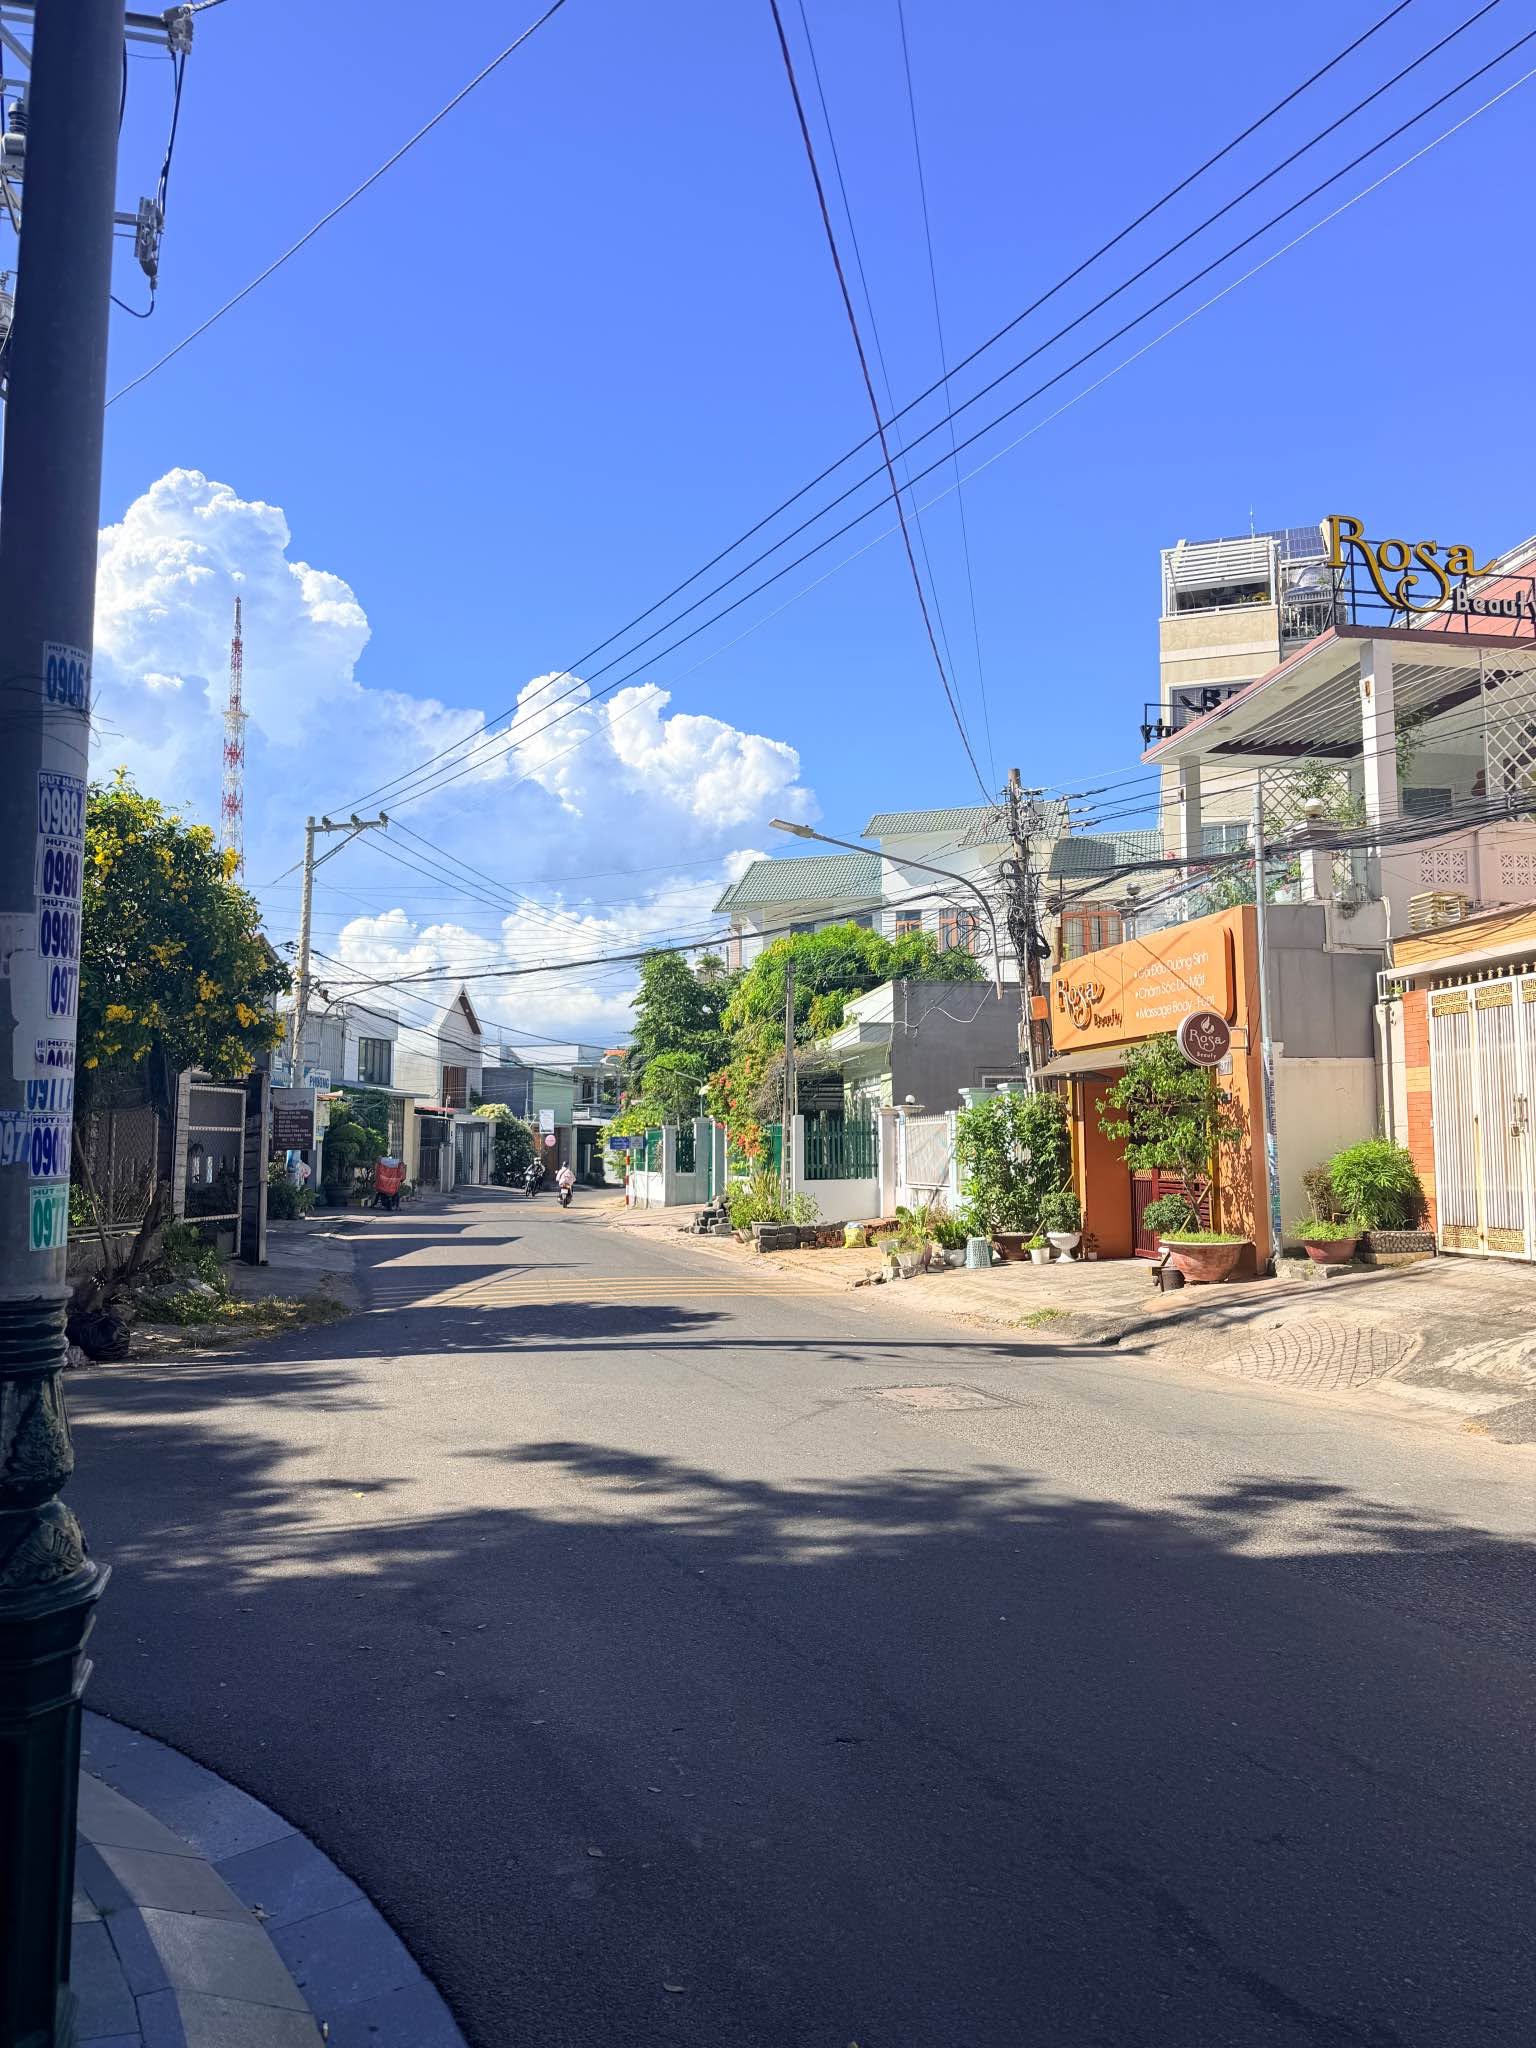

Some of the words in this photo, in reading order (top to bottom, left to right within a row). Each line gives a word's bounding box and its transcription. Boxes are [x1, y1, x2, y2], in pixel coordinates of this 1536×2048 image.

[1326, 514, 1497, 613] Rosa
[43, 849, 78, 899] 0988
[1189, 1029, 1226, 1052] Rosa
